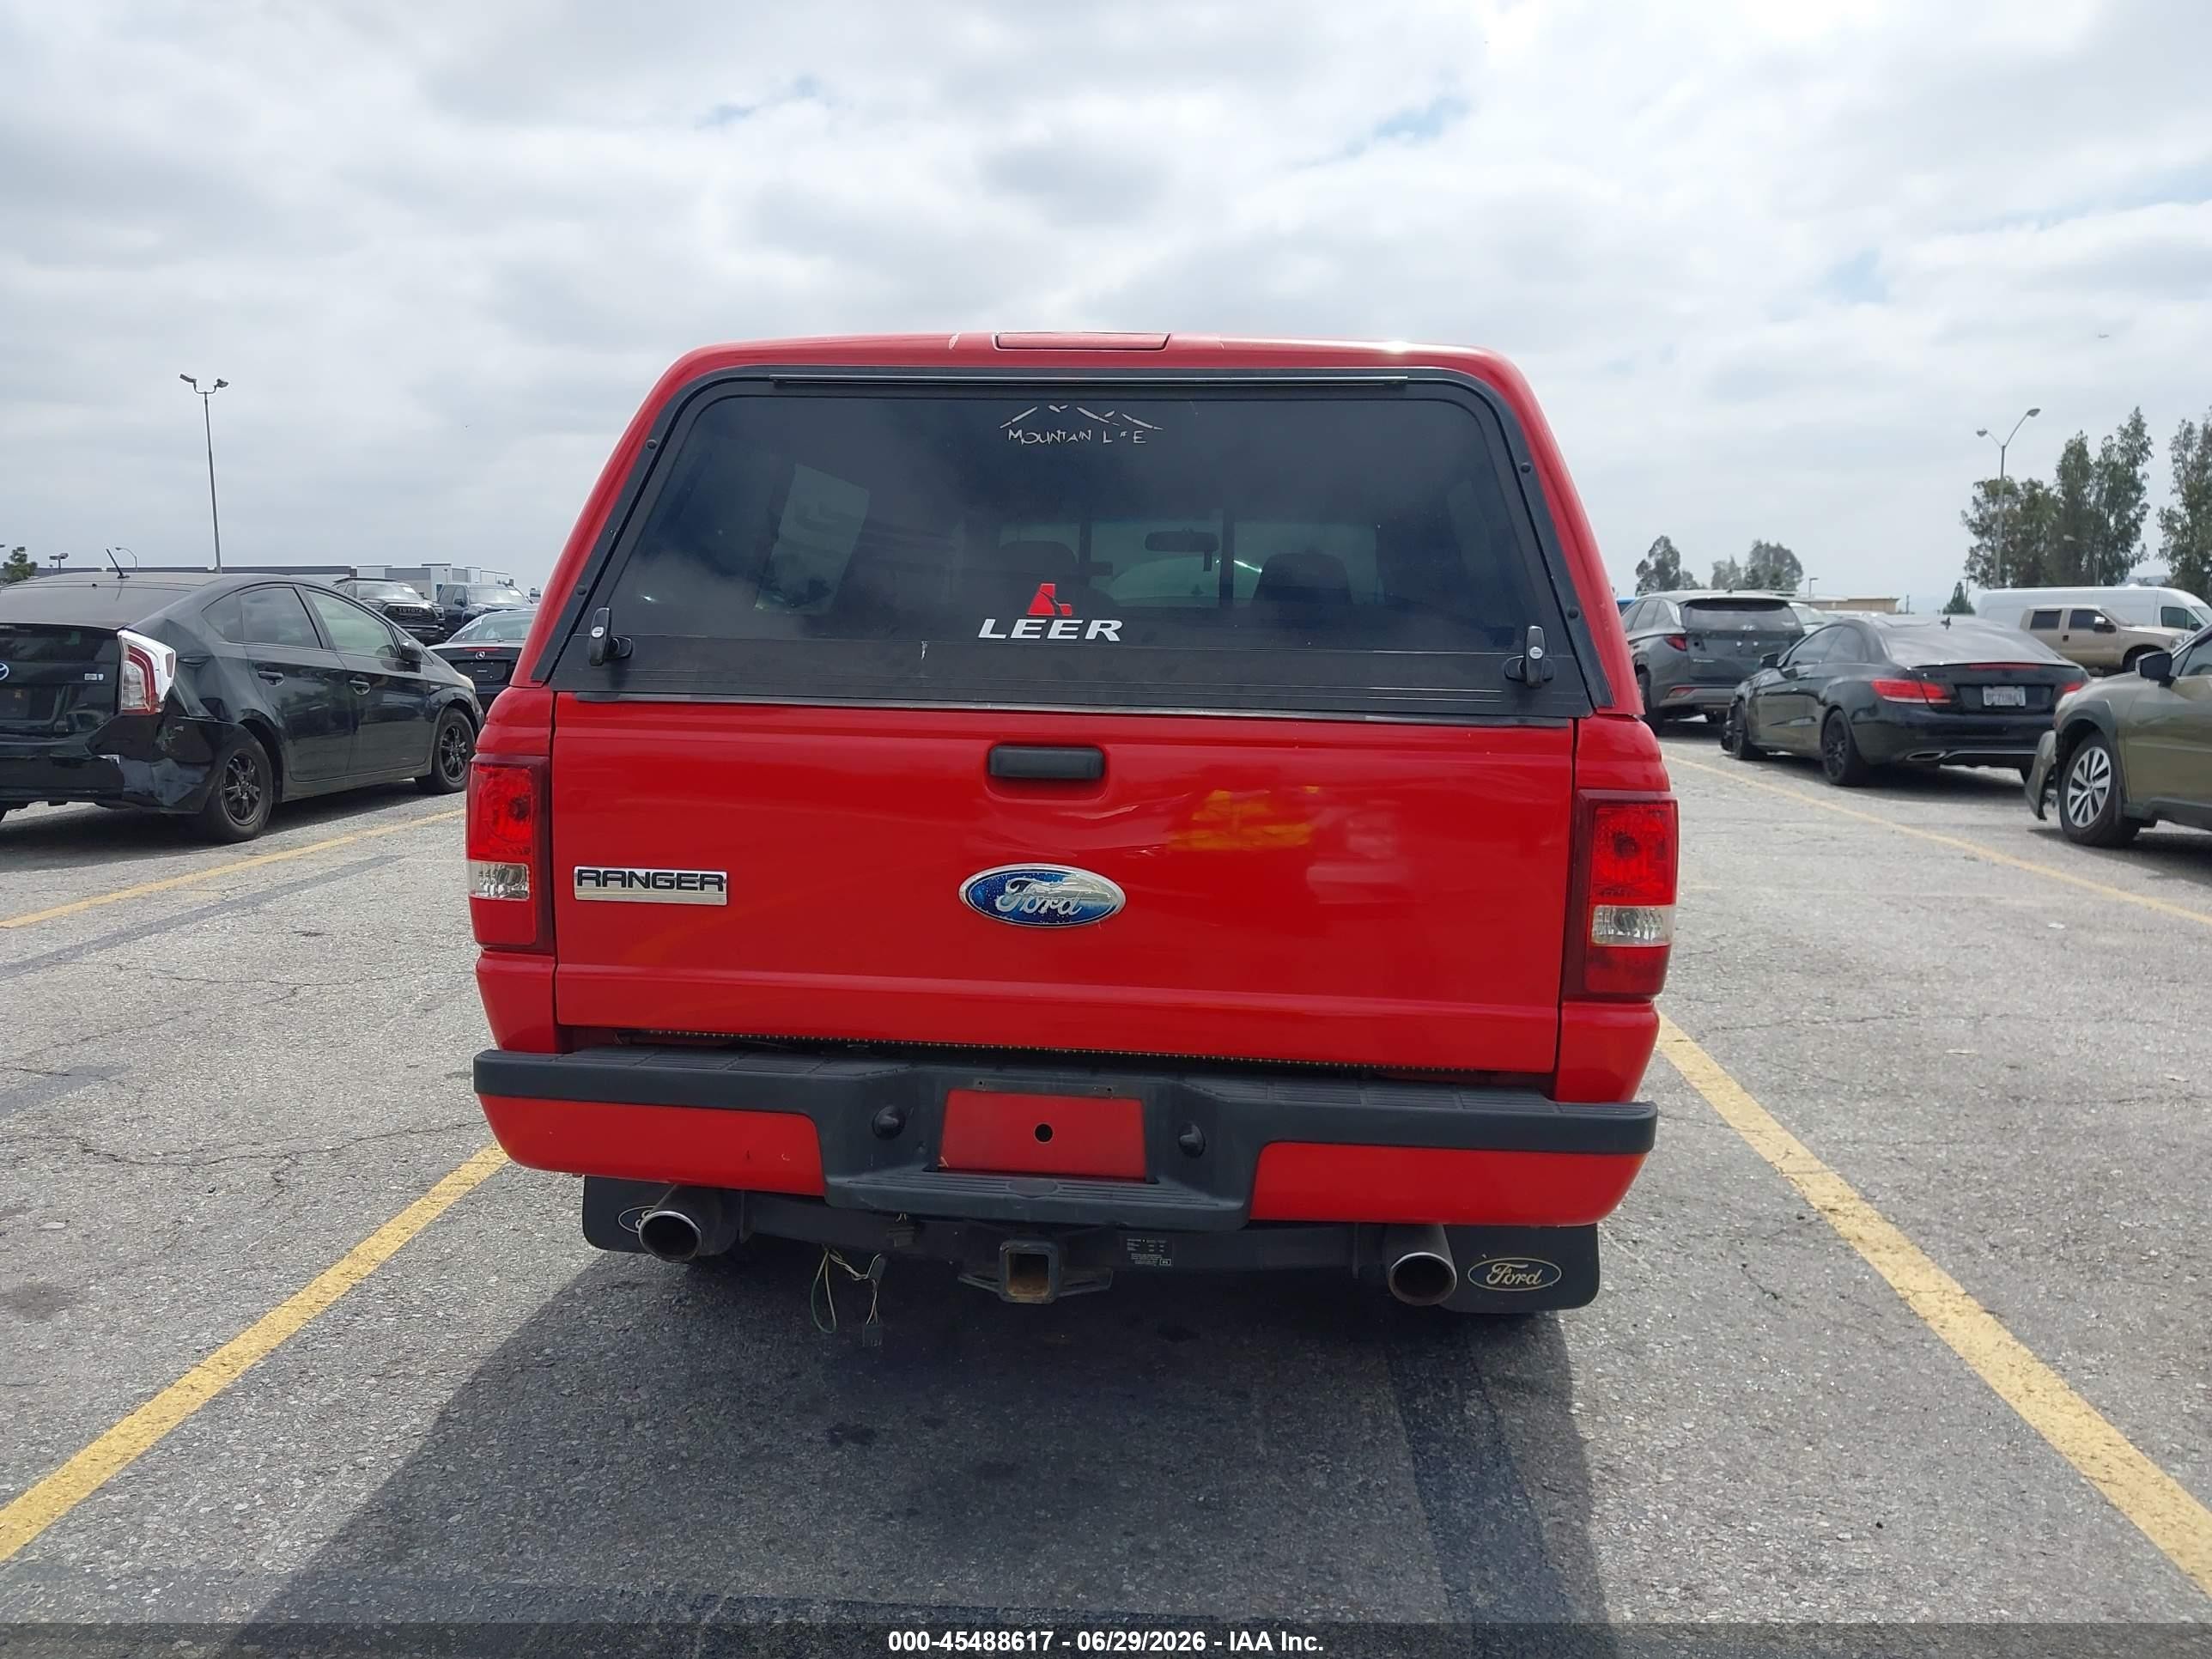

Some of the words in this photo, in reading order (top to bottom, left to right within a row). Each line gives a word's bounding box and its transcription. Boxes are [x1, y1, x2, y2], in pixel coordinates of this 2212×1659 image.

[1008, 429, 1091, 445] MOUNTAIN
[977, 618, 1123, 641] LEER
[577, 869, 724, 891] RANGER
[995, 877, 1083, 915] Ford
[1486, 1262, 1543, 1285] Ford
